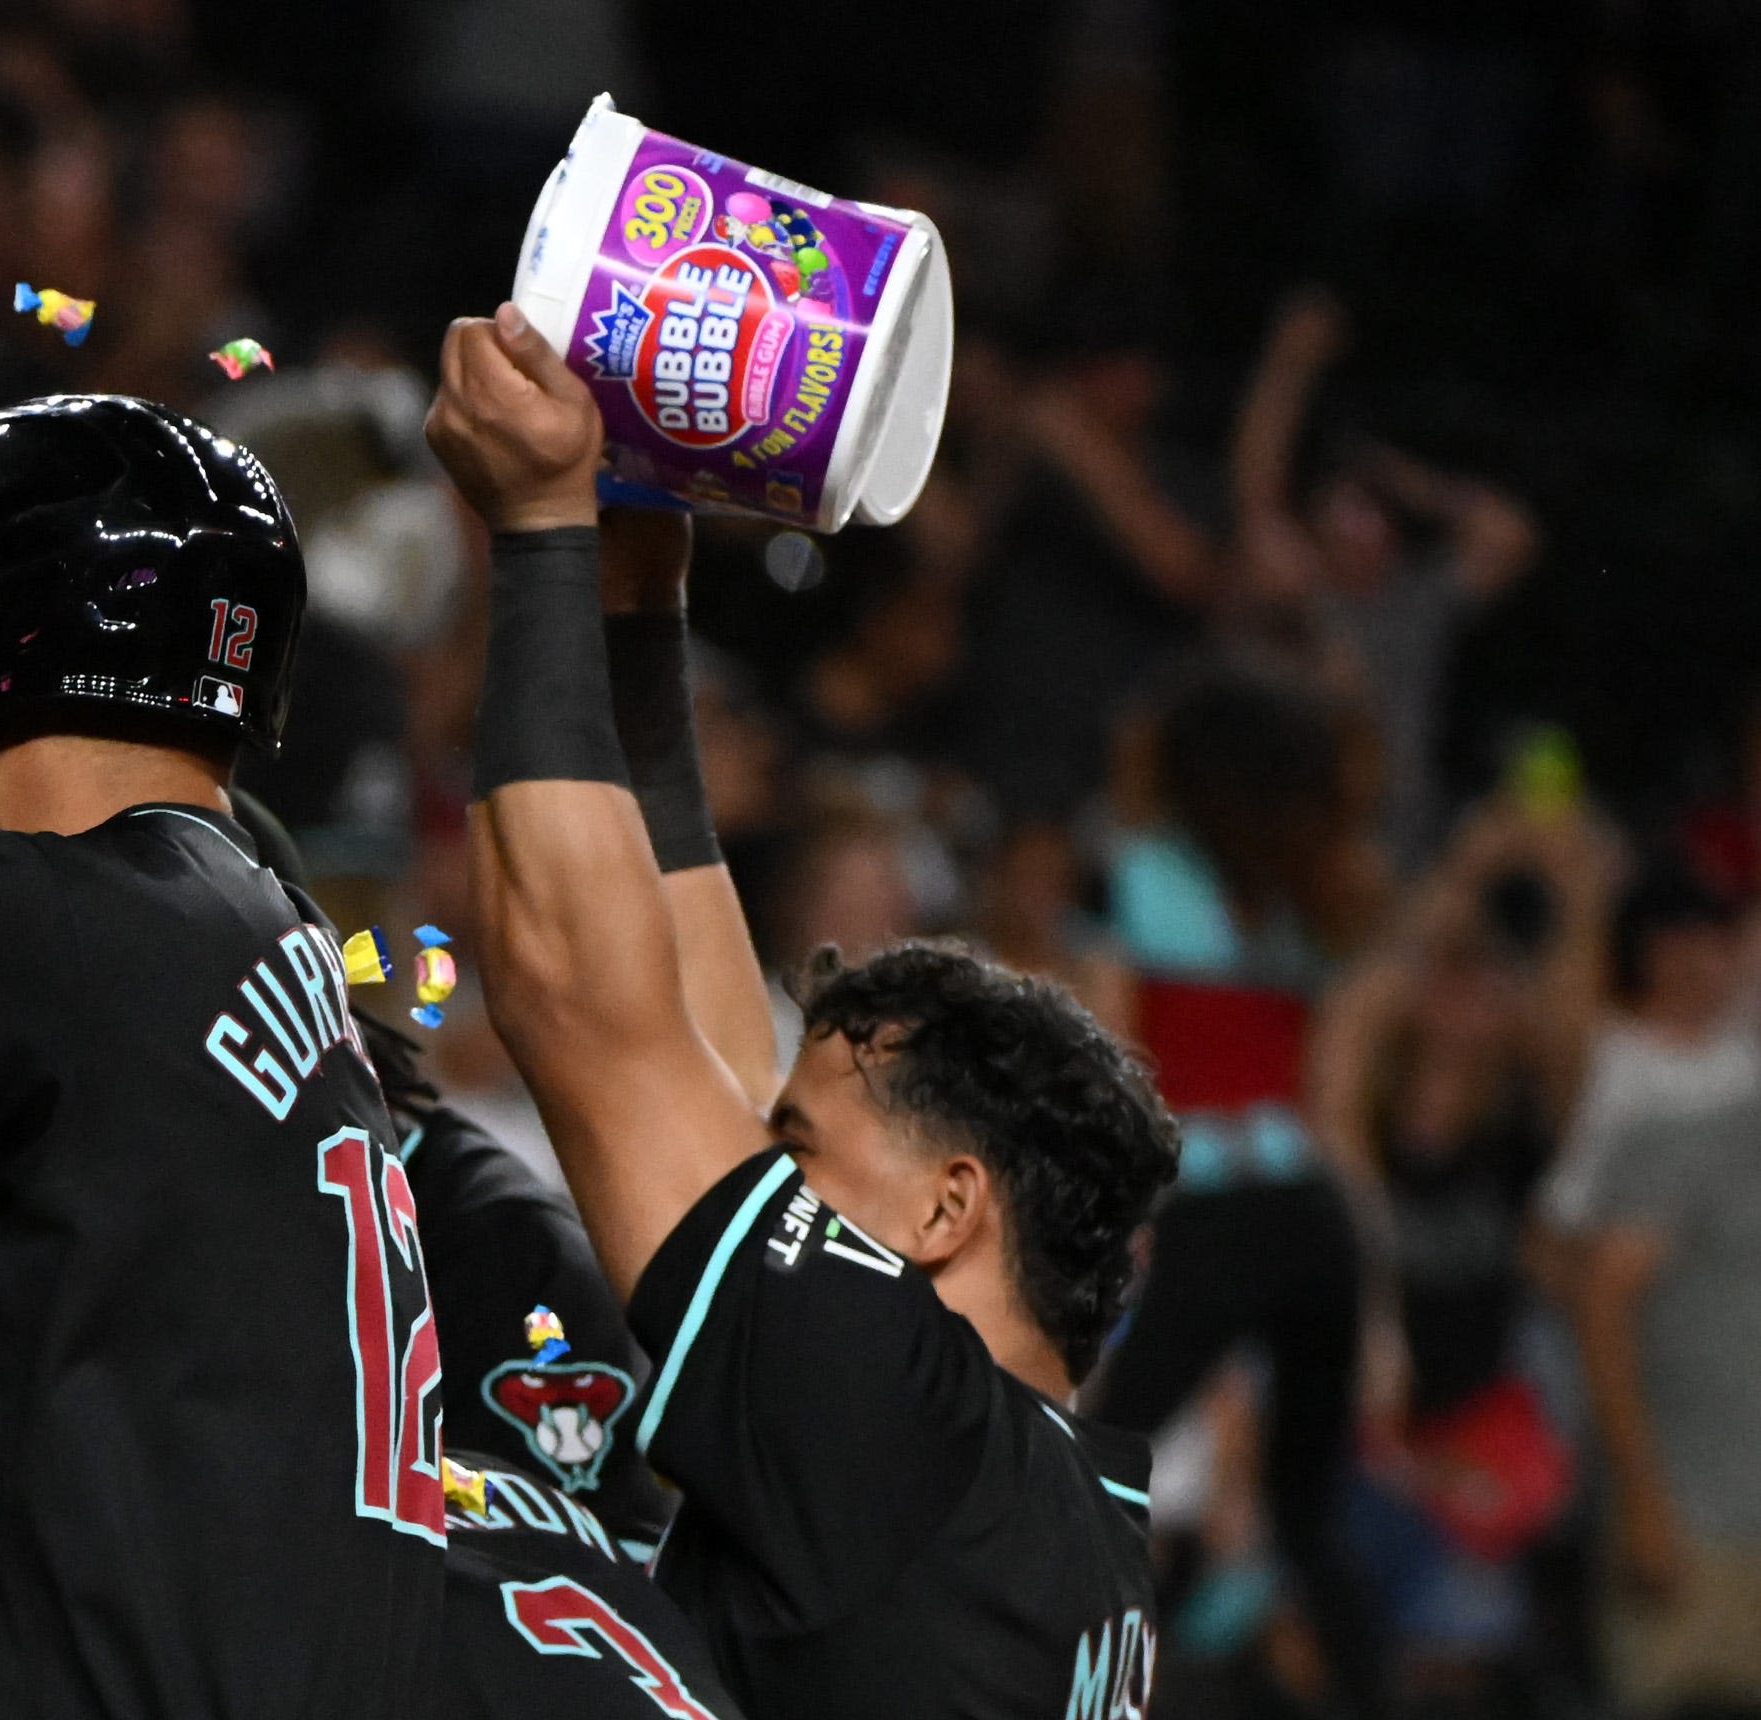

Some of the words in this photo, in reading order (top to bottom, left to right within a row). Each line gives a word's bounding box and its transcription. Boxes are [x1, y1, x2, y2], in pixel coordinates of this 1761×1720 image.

[625, 172, 687, 249] 300
[654, 262, 713, 431] DUBBLE
[693, 264, 753, 434] BUBBLE
[756, 321, 786, 364] GUM
[783, 323, 844, 433] FLAVORS!
[208, 598, 258, 671] 12
[317, 1125, 447, 1548] 12
